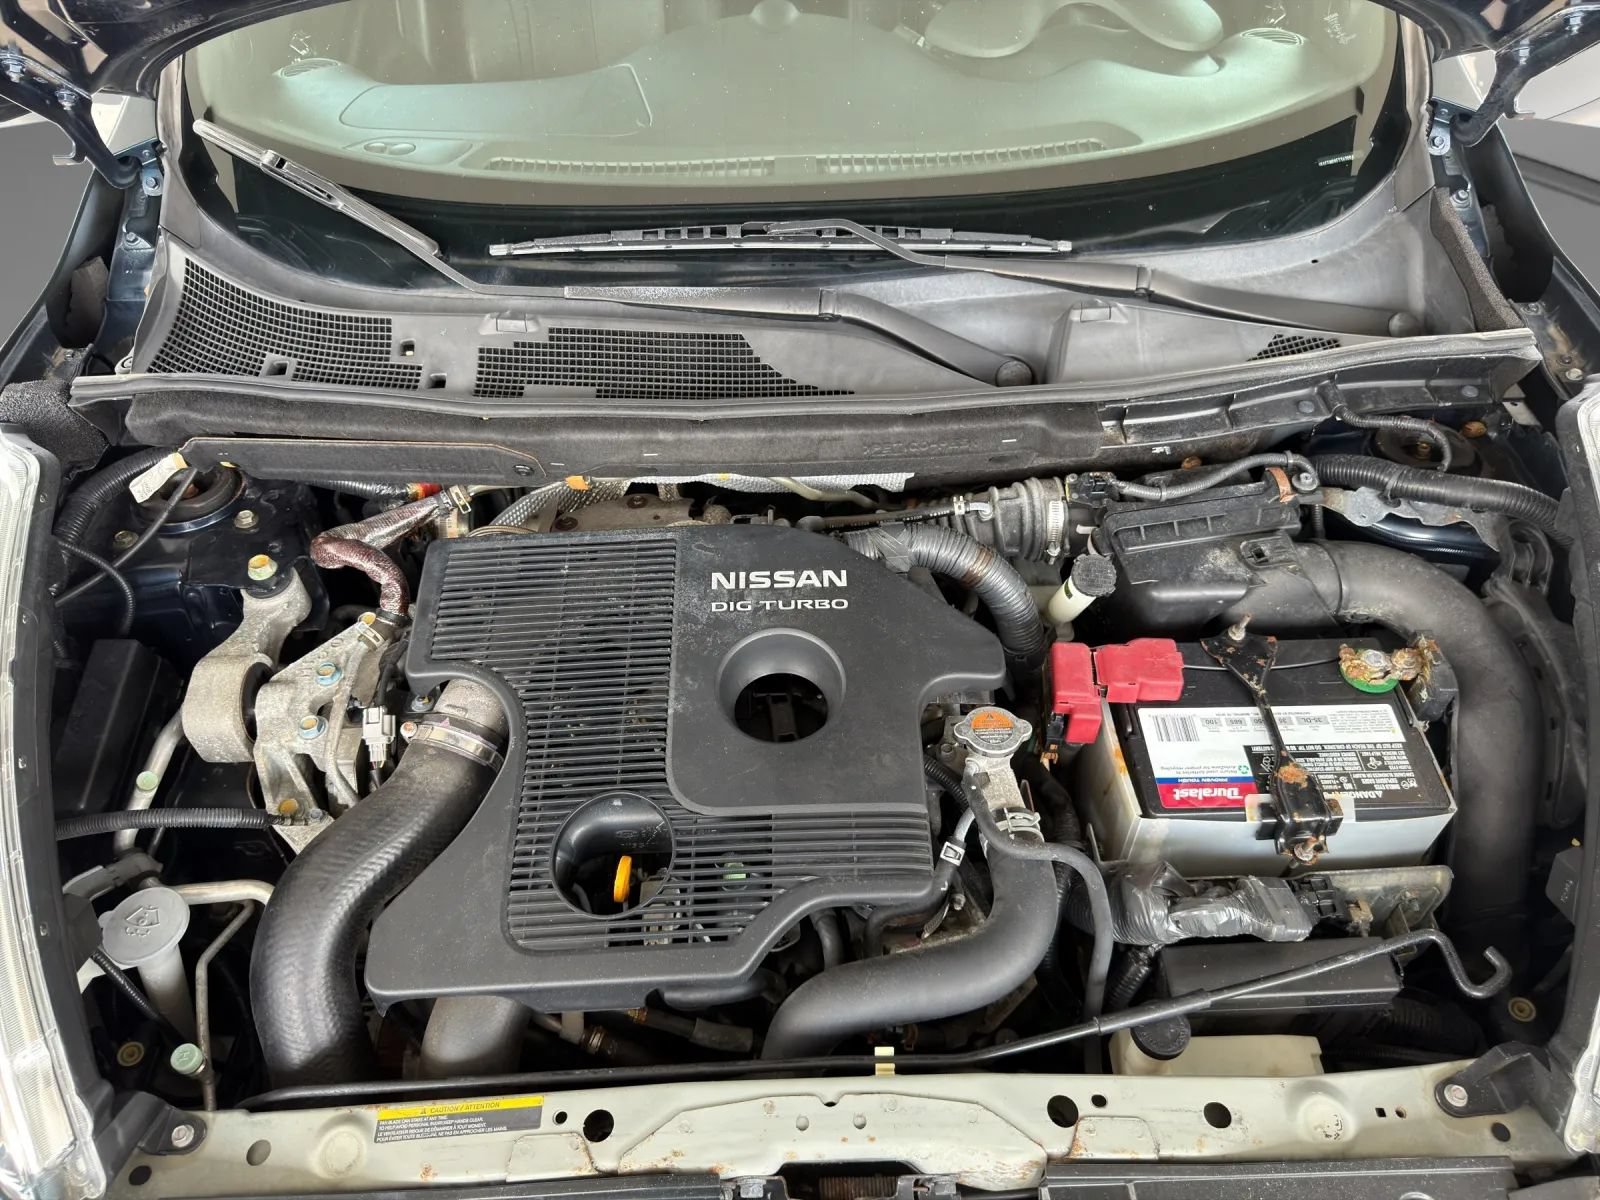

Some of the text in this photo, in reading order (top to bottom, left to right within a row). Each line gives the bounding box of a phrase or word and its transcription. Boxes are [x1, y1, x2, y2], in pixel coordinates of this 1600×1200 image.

[712, 570, 847, 589] NISSAN
[712, 599, 848, 611] DIG TURBO
[1173, 788, 1243, 800] Duralast
[430, 1105, 458, 1113] CAUTION
[465, 1101, 499, 1110] ATTENTION
